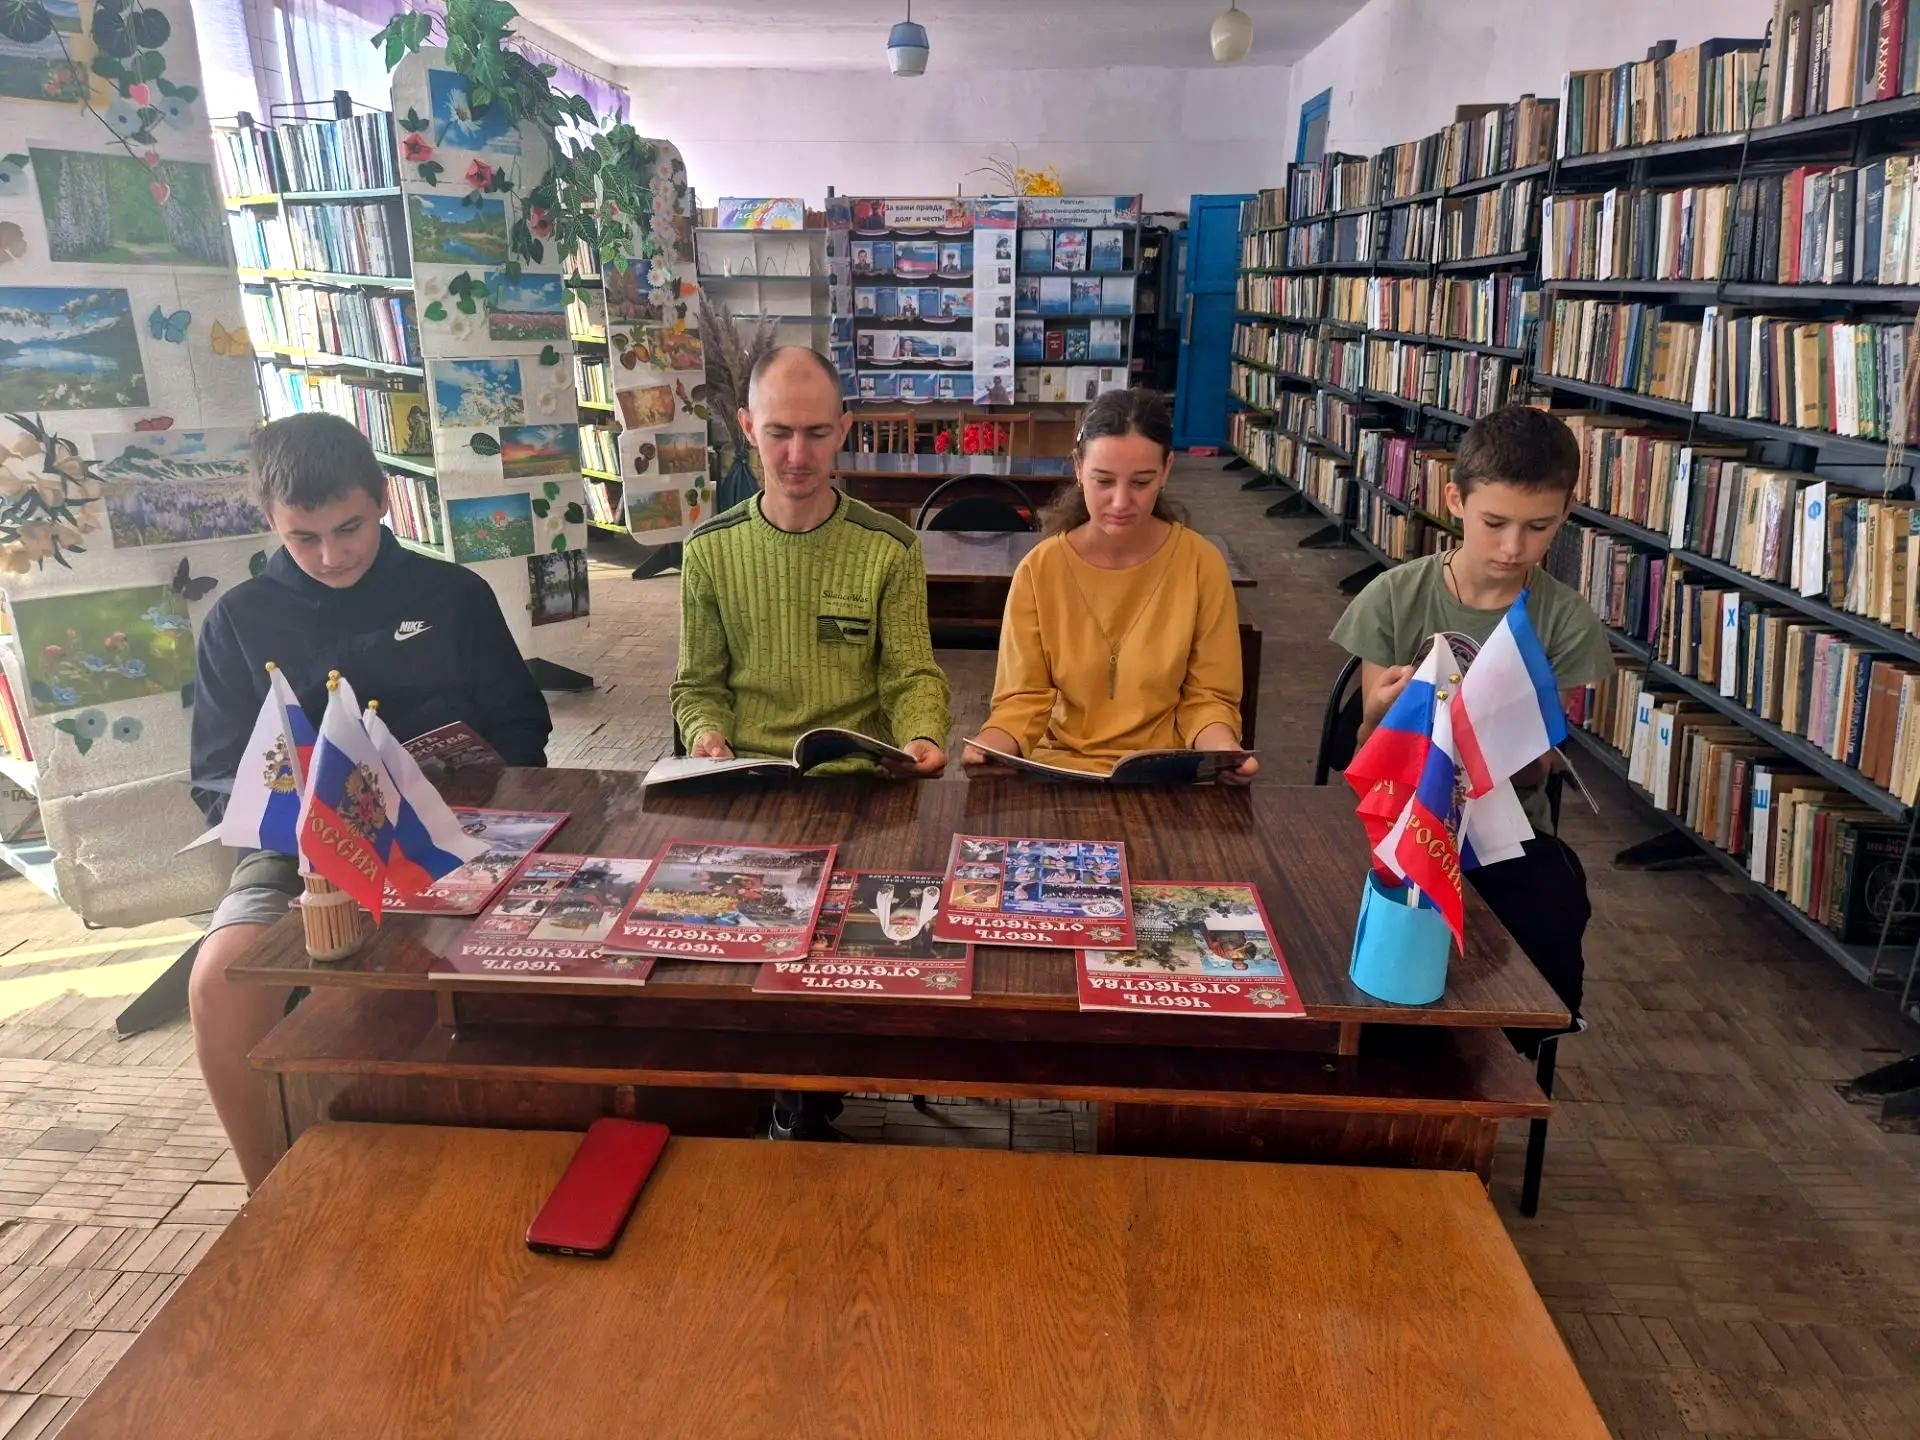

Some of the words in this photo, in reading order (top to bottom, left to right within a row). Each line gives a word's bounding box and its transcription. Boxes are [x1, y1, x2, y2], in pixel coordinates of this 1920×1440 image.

[885, 203, 894, 211] За
[915, 204, 945, 213] правда,
[894, 215, 912, 223] долг
[922, 214, 945, 223] честь!
[1807, 499, 1823, 521] Ф
[399, 620, 425, 633] NIKE
[1660, 727, 1669, 746] Ч
[1753, 788, 1768, 809] Ш
[308, 804, 379, 882] ОССИЯ
[947, 915, 1085, 932] ОТЕЧЕСТВА
[623, 925, 763, 943] ОТЕЧЕСТВА
[974, 929, 1053, 942] ЧЕСТЬ
[460, 945, 603, 960] ОТЕЧЕСТВА
[646, 940, 725, 955] ЧЕСТЬ
[482, 959, 561, 972] ЧЕСТЬ
[774, 963, 921, 977] ОТЕЧЕСТВА
[801, 976, 884, 990] ЧЕСТЬ
[1088, 977, 1241, 994] ОТЕЧЕСТВА
[1123, 993, 1212, 1008] ЧЕСТЬ
